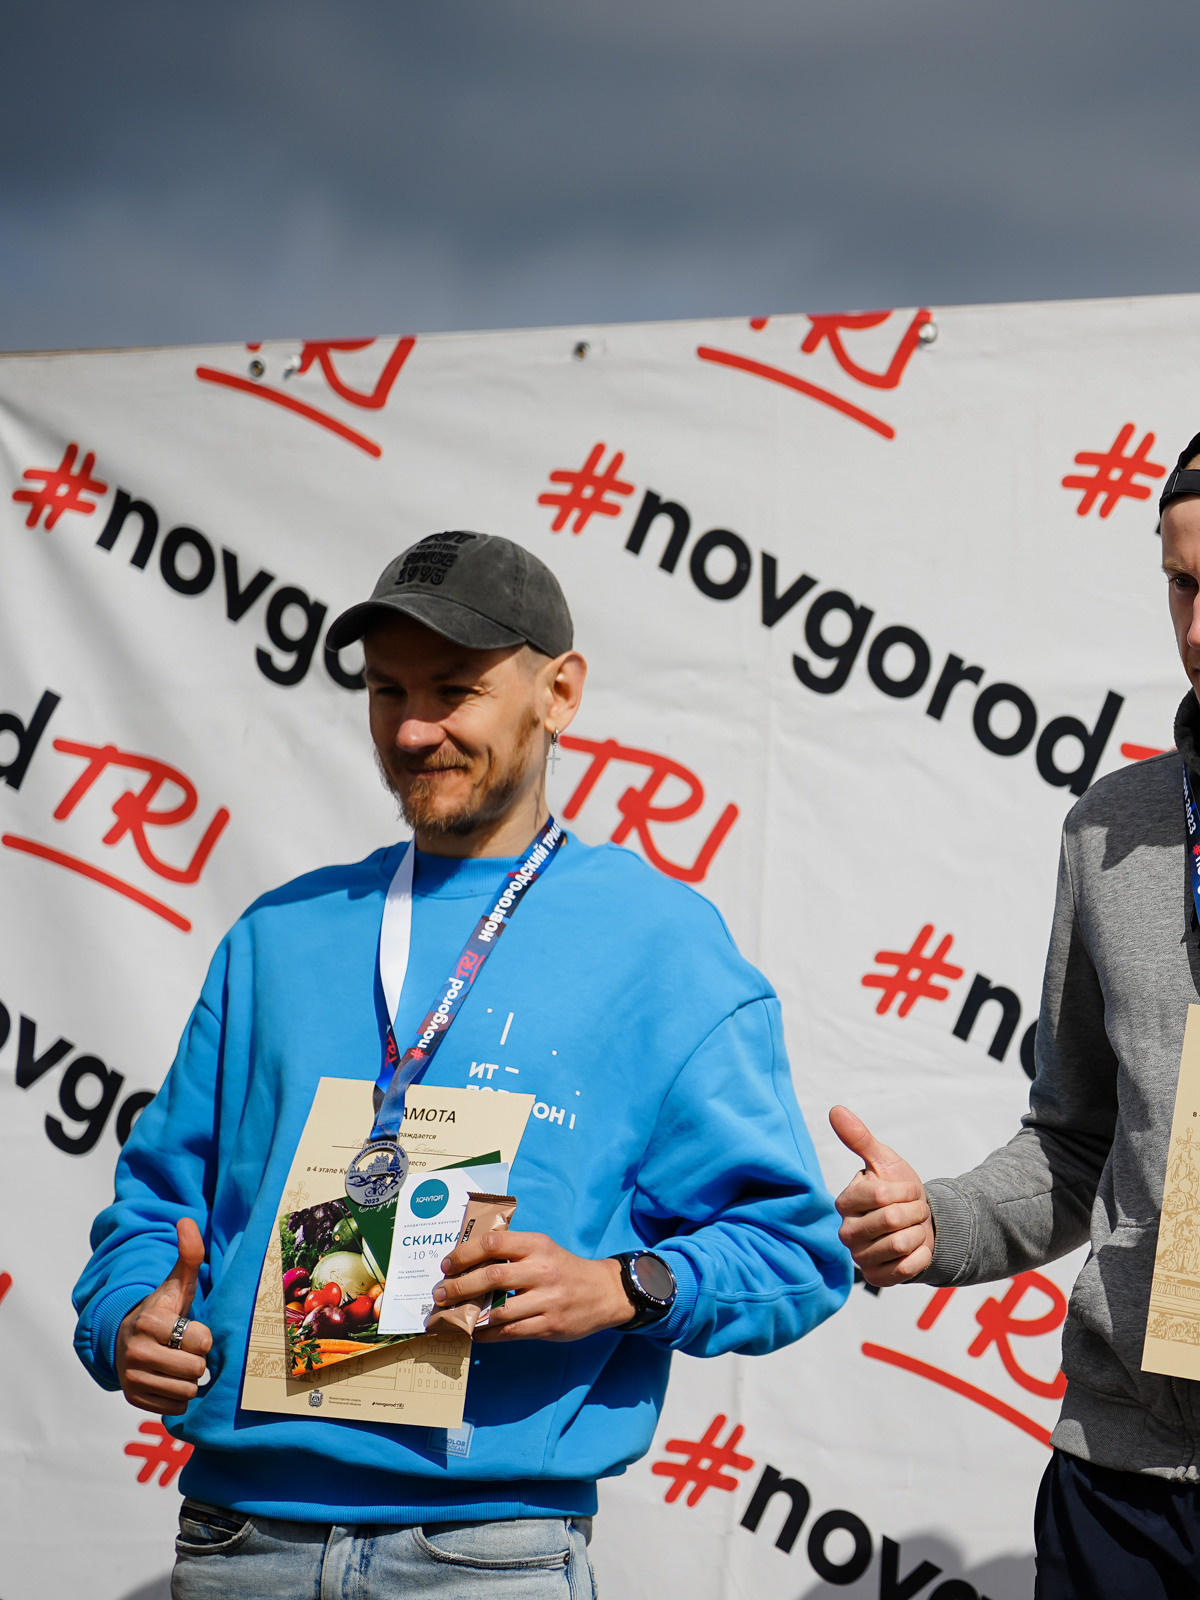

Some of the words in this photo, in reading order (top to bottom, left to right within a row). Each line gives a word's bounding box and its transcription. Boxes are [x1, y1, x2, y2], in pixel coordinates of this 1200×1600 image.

[538, 442, 1178, 795] #novgorod
[1185, 799, 1197, 835] 2023
[478, 843, 551, 942] НОВГОРОДСКИЙ
[469, 1061, 499, 1080] ИТ
[403, 1107, 457, 1124] АМОТА
[363, 1197, 380, 1205] 2023
